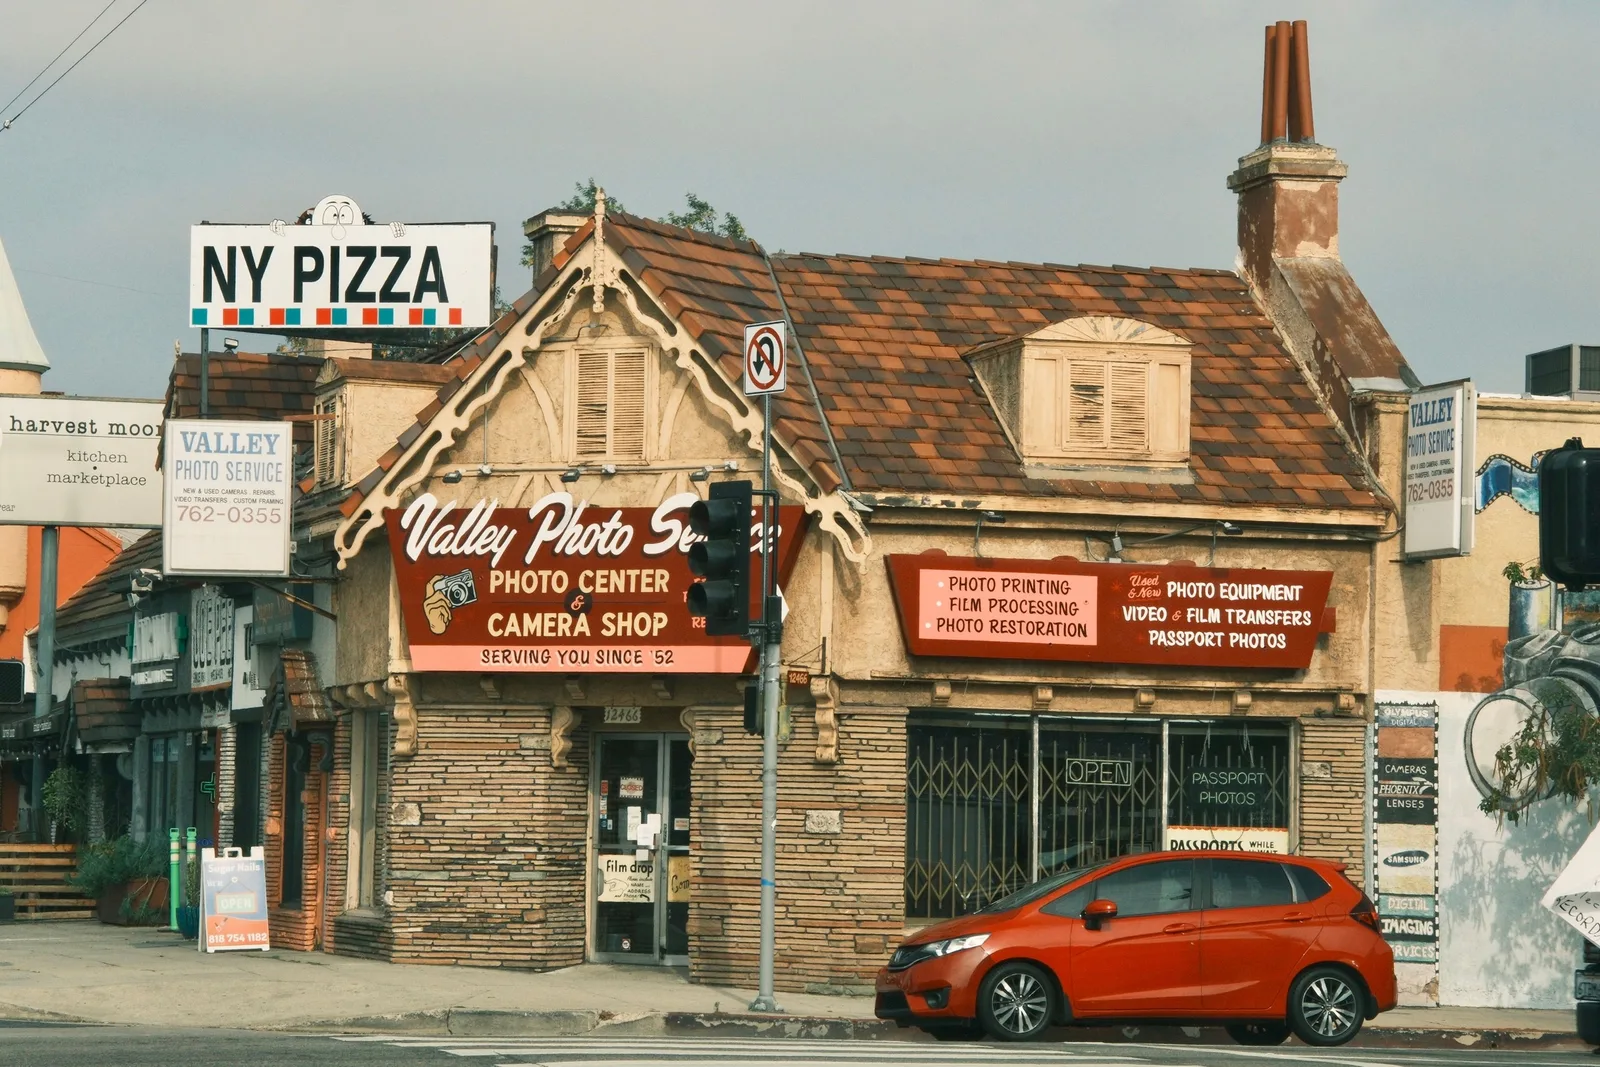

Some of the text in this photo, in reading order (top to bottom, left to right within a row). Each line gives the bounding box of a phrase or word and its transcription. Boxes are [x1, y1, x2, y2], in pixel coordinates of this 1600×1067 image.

[203, 246, 449, 303] NY PIZZA
[1411, 397, 1454, 428] VALLEY
[9, 415, 162, 437] harvest moo
[179, 431, 280, 455] VALLEY
[1408, 428, 1454, 457] PHOTO SERVICE
[66, 450, 128, 464] kitchen
[47, 472, 147, 487] marketplace
[175, 460, 283, 482] PHOTO SERVICE
[1408, 479, 1453, 502] 762-0355
[177, 505, 282, 524] 762-0355
[400, 492, 517, 568] Valley
[524, 491, 634, 565] Photo
[489, 569, 670, 594] PHOTO CENTER
[949, 576, 1071, 595] PHOTO PRINTING
[1129, 575, 1159, 587] Used
[1136, 586, 1162, 598] New
[1166, 581, 1303, 601] PHOTO EQUIPMENT
[570, 594, 585, 611] &
[949, 597, 1079, 616] FILM PROCESSING
[1122, 605, 1312, 626] VIDEO & FILM TRANSFERS
[487, 612, 591, 637] CAMERA
[600, 612, 669, 637] SHOP
[936, 617, 1087, 638] PHOTO RESTORATION
[1148, 630, 1286, 649] PASSPORT PHOTOS
[481, 648, 675, 665] SERVING YOU SINCE '52
[788, 674, 808, 685] 12466
[605, 708, 639, 722] 12466
[1384, 707, 1429, 718] OLYMPUS
[1068, 761, 1130, 784] OPEN
[1192, 771, 1265, 785] PASSPORT
[1385, 764, 1427, 775] CAMERAS
[620, 784, 643, 792] CLOSED
[1379, 784, 1420, 794] PHOENIX
[1200, 791, 1256, 805] PHOTOS
[1386, 799, 1425, 809] LENSES
[1249, 841, 1275, 849] WHILE
[1387, 855, 1425, 864] SAMSUNG
[208, 863, 236, 874] Sugar
[630, 860, 654, 877] drop
[221, 898, 251, 909] OPEN
[1388, 897, 1429, 911] DIGITAL
[1381, 919, 1433, 936] IMAGING
[209, 932, 267, 943] 818 754 1182
[1392, 944, 1435, 958] RVICES
